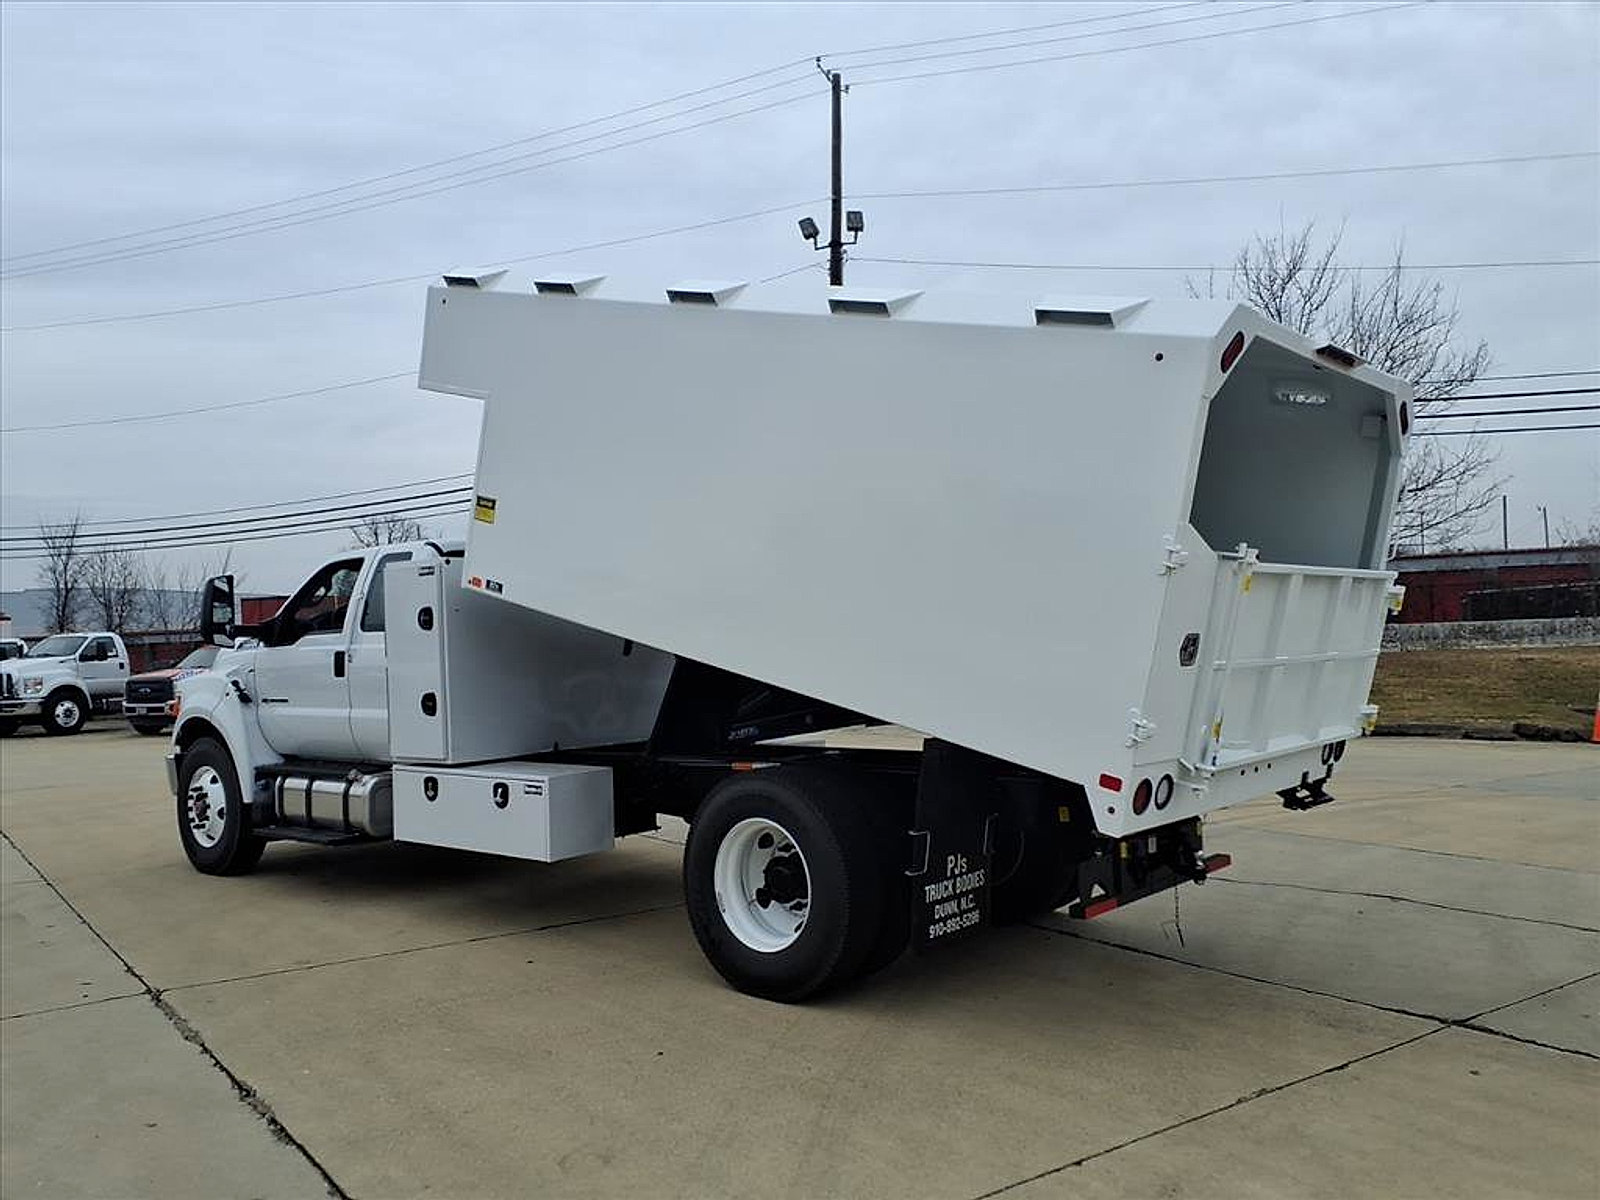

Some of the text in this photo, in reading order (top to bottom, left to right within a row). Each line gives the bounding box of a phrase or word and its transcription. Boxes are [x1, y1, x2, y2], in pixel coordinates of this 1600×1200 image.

[947, 854, 967, 877] PJs
[925, 868, 985, 903] TRUCK BODIES
